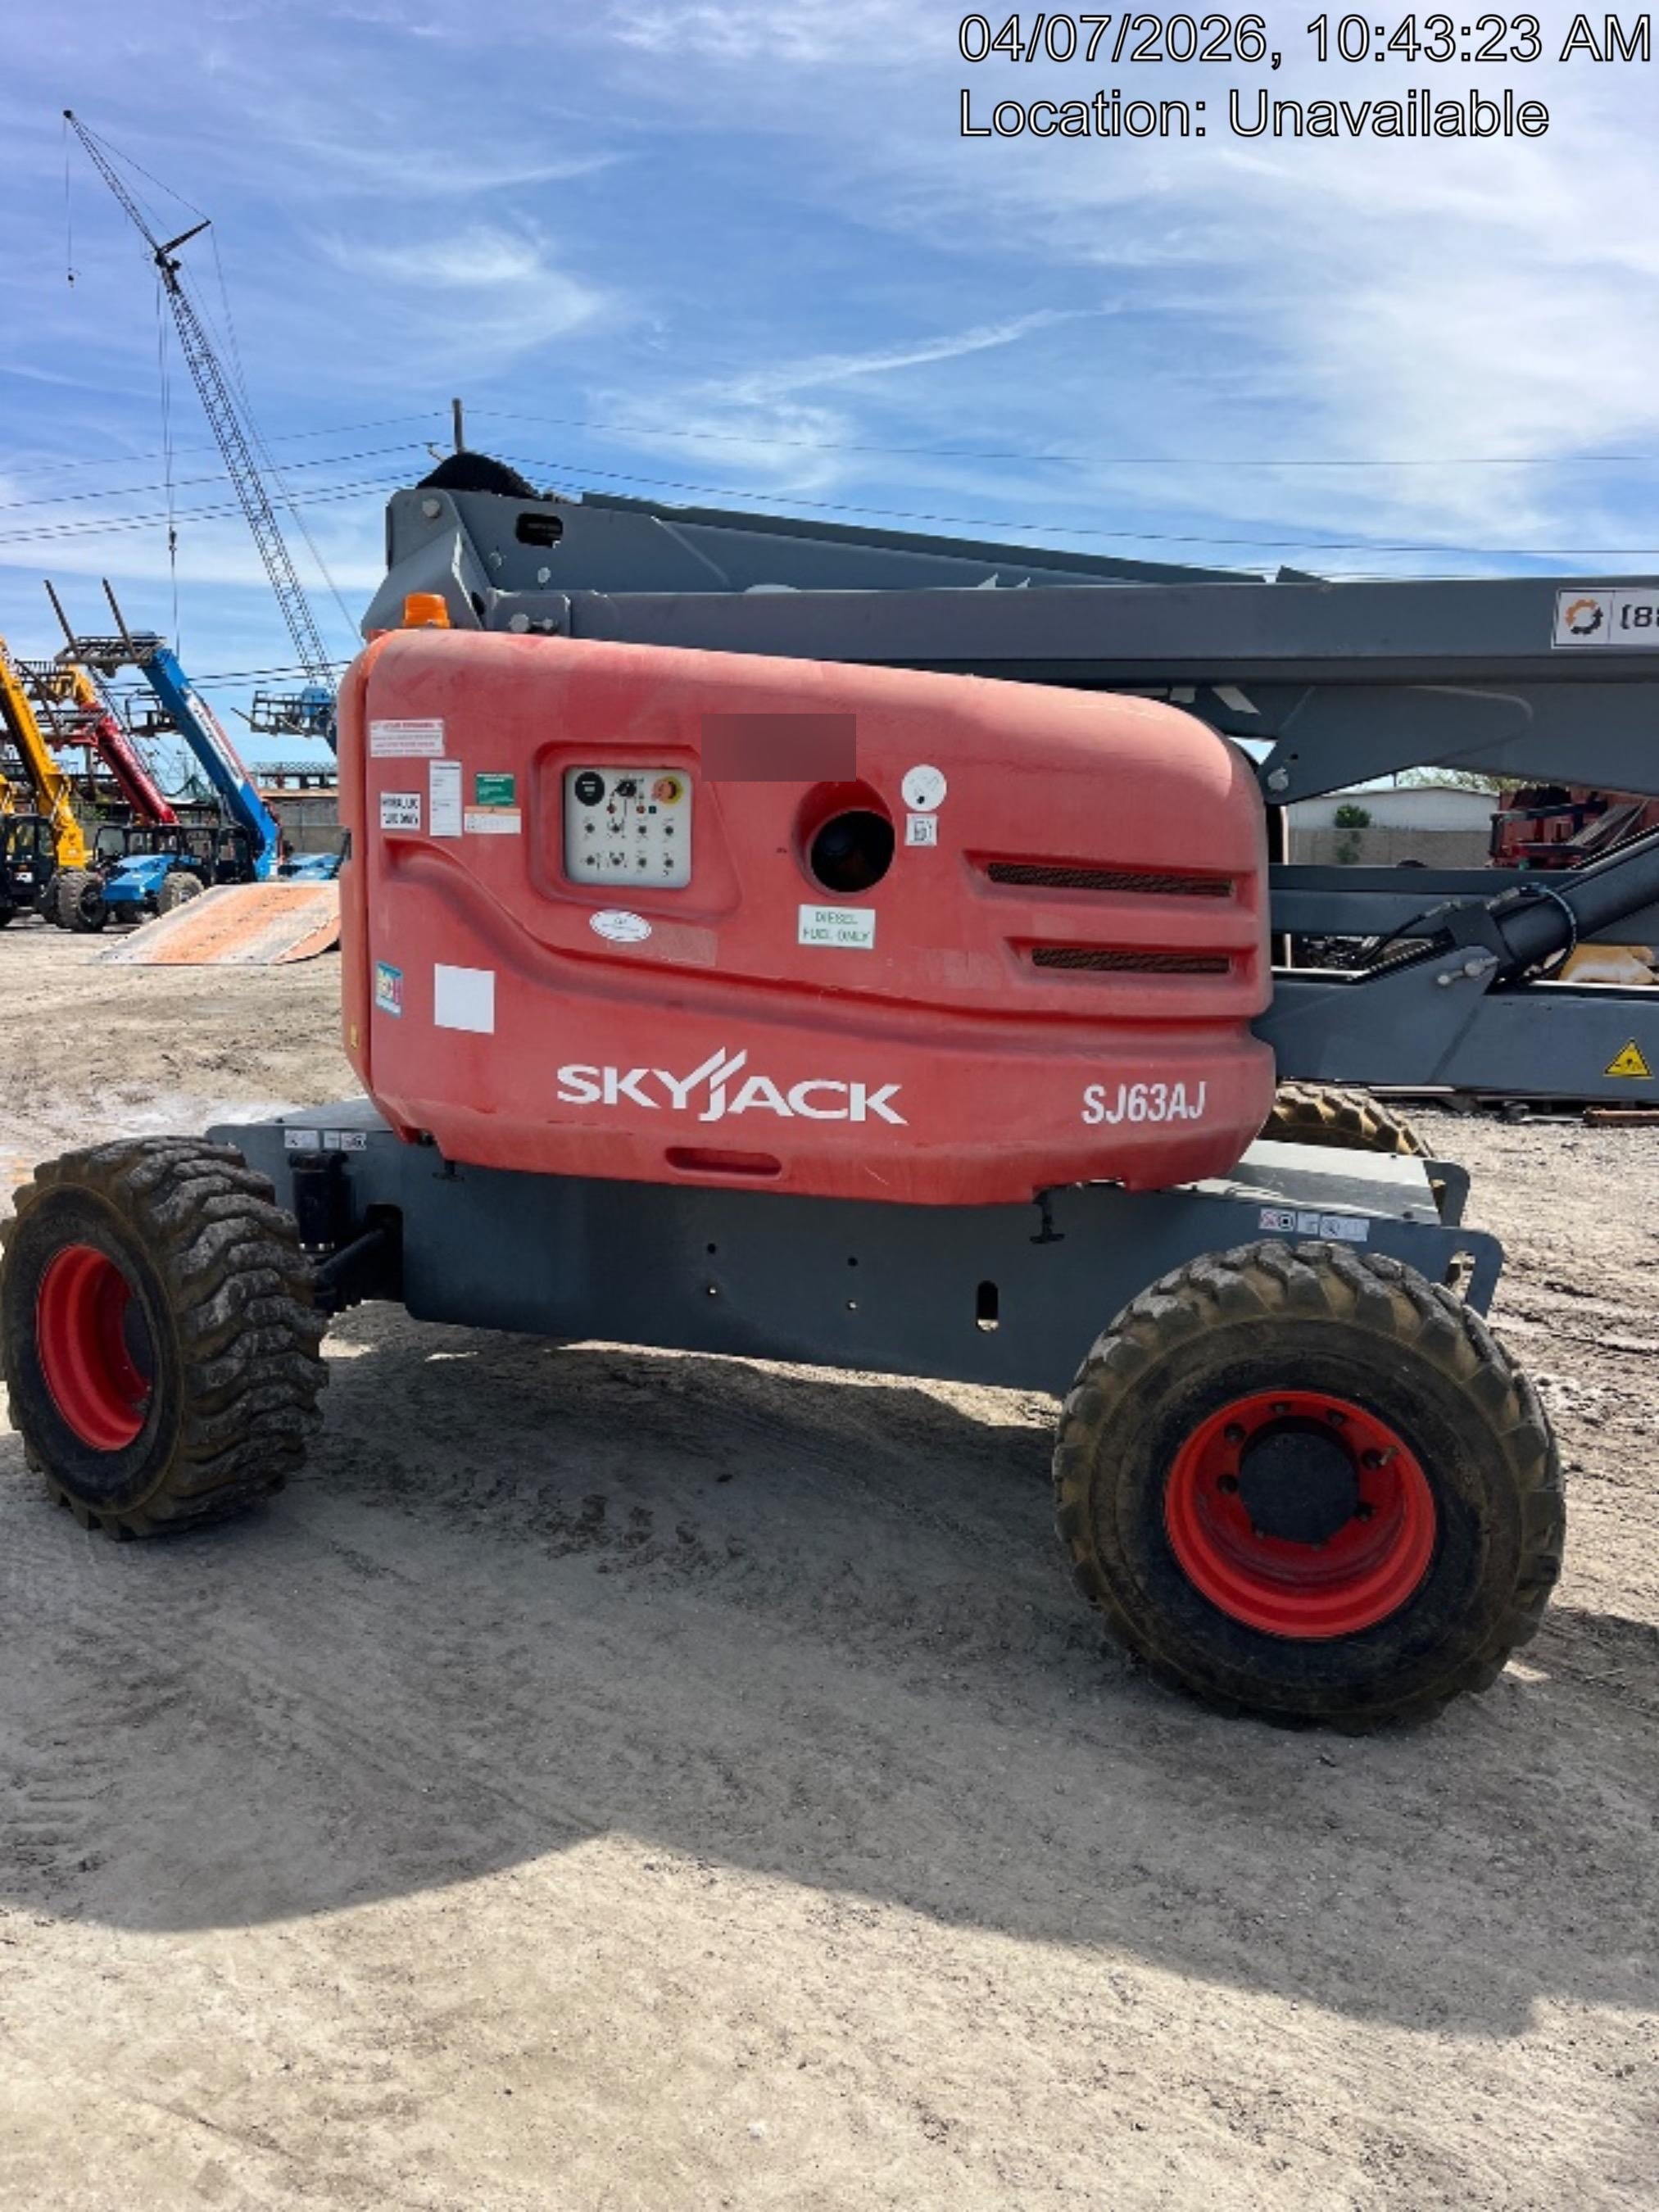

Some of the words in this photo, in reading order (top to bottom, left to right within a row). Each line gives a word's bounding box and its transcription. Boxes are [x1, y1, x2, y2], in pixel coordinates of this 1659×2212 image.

[1620, 604, 1659, 629] (8
[556, 1046, 909, 1126] SKYJACK
[1081, 1081, 1207, 1124] SJ63AJ
